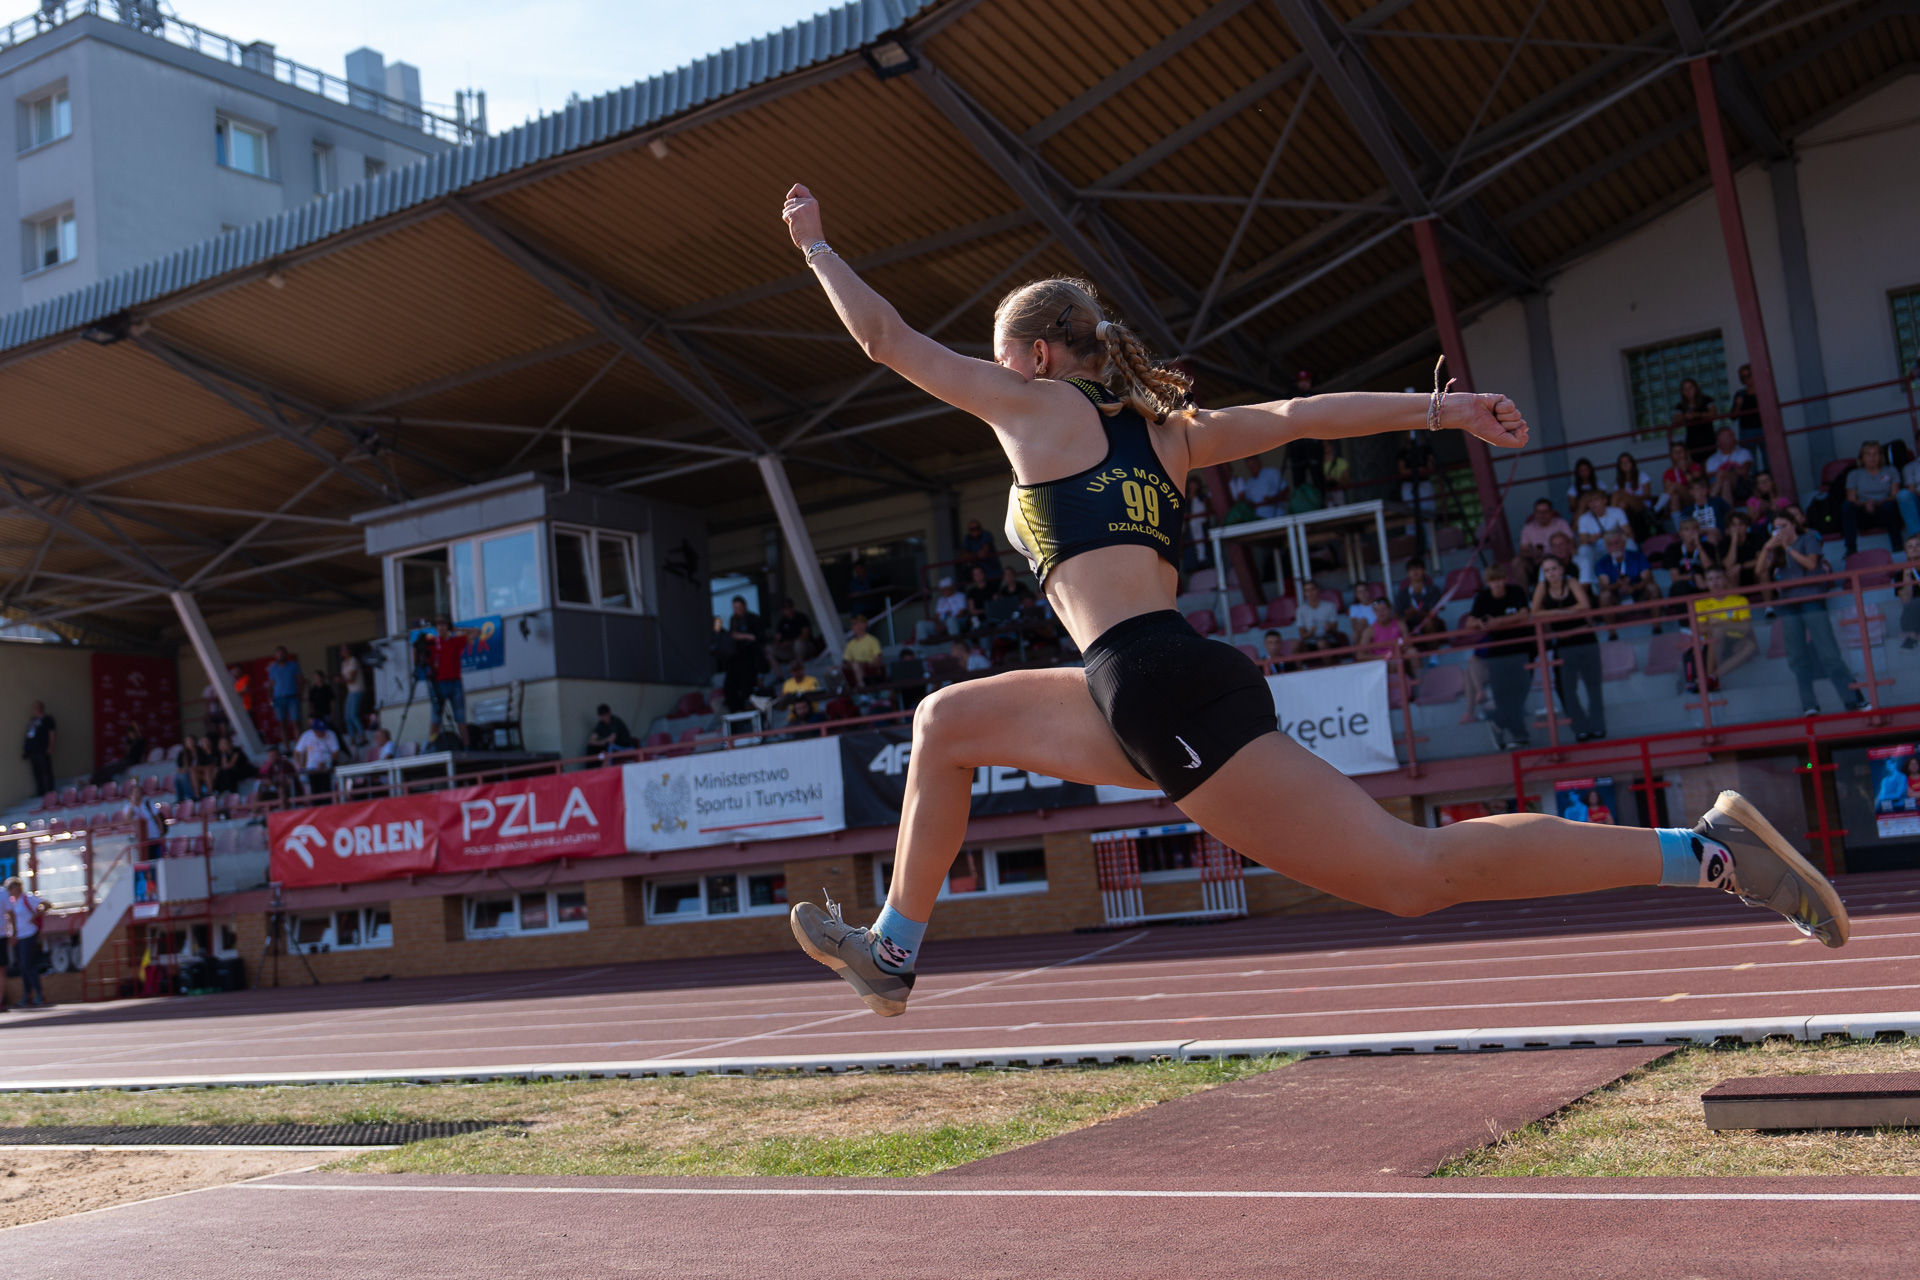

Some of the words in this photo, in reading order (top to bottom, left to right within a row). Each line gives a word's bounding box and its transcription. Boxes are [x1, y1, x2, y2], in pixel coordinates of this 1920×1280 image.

[1086, 468, 1128, 492] UKS
[1133, 467, 1180, 510] MOSIR
[1122, 480, 1160, 527] 99
[1108, 522, 1171, 546] DZIAŁDOWO
[694, 767, 790, 791] Ministerstwo
[461, 786, 599, 842] PZLA
[695, 793, 744, 816] Sportu
[746, 791, 752, 808] i
[754, 782, 824, 808] Turystyki
[333, 819, 424, 858] ORLEN
